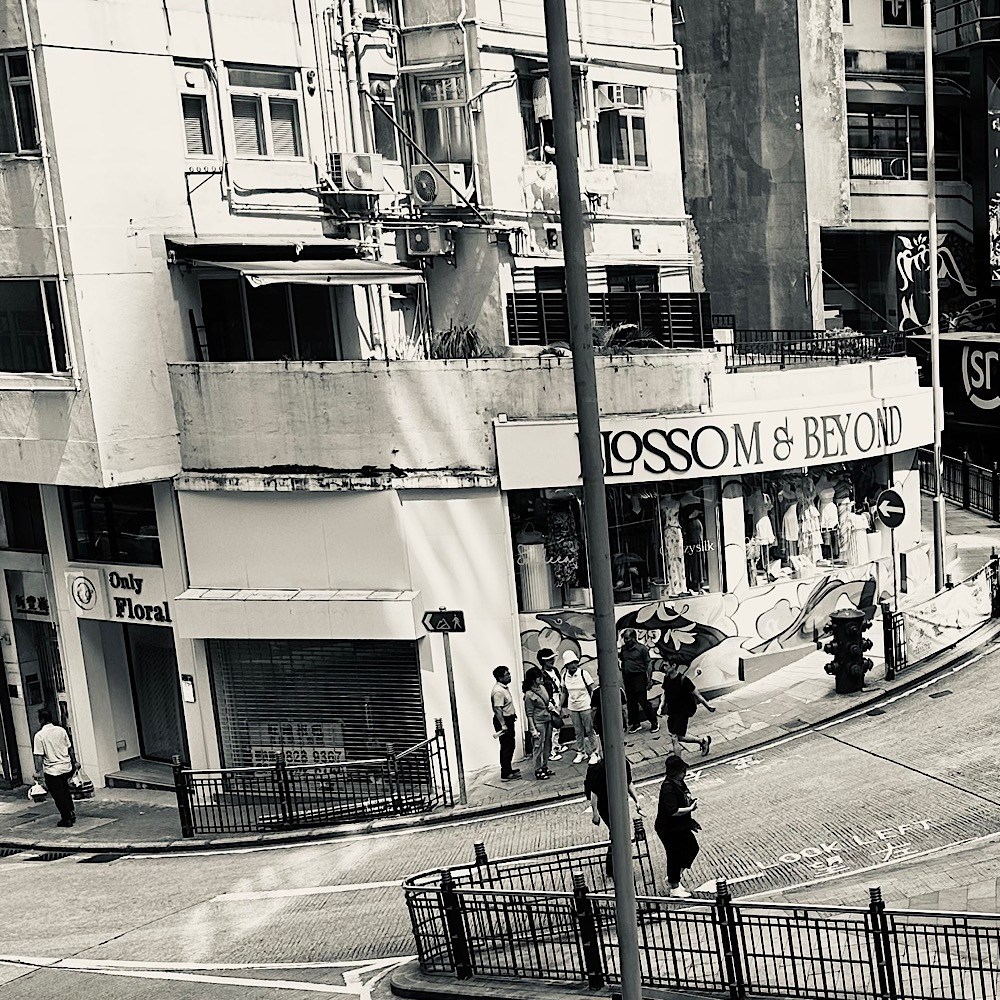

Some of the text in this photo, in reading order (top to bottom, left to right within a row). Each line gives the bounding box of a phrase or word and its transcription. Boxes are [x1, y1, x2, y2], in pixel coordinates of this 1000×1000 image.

[576, 406, 902, 478] LOSSOM & BEYOND
[109, 572, 143, 594] Only
[114, 597, 172, 622] Floral
[756, 819, 932, 870] LOOK LEFT
